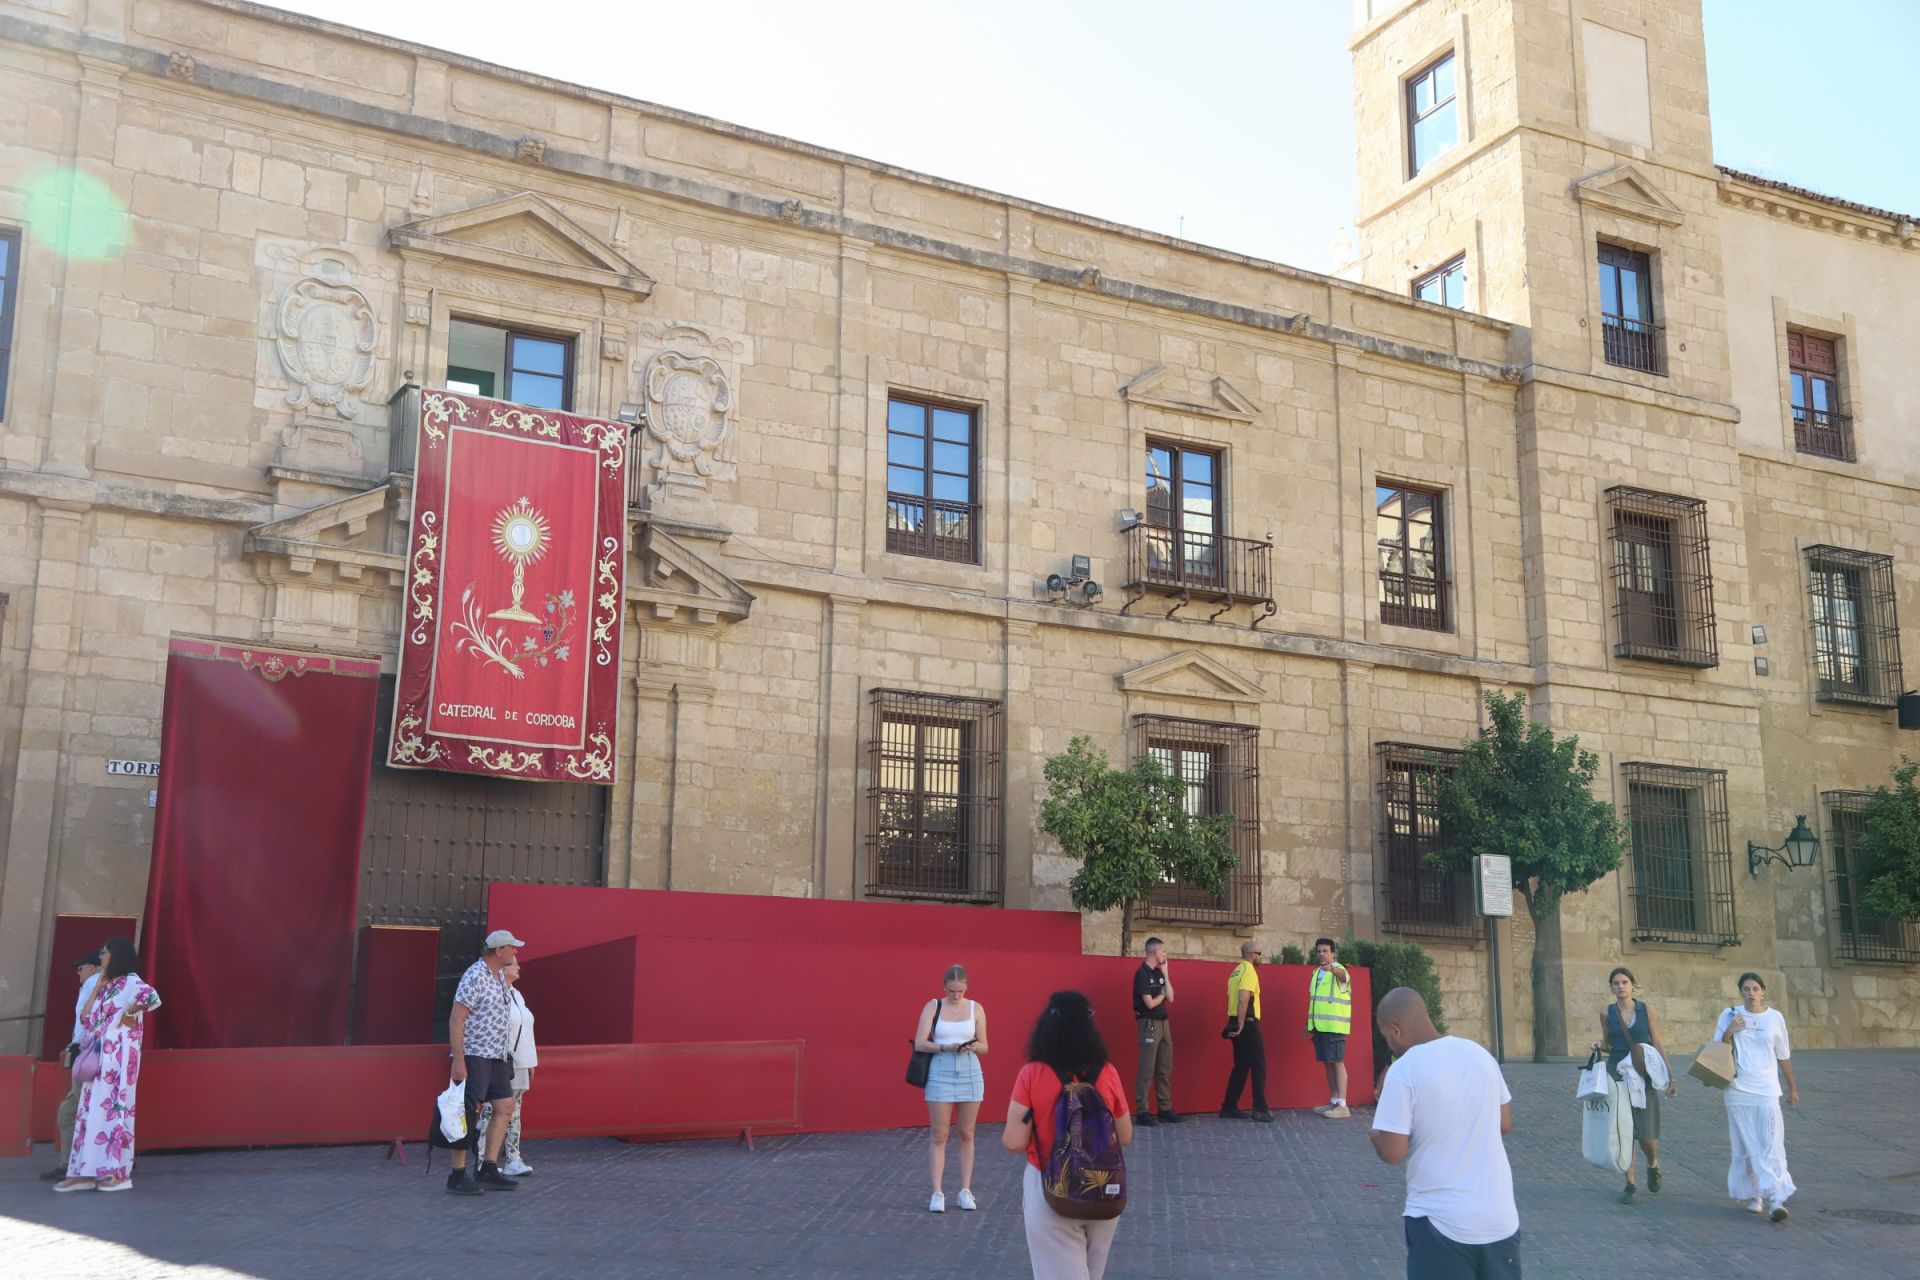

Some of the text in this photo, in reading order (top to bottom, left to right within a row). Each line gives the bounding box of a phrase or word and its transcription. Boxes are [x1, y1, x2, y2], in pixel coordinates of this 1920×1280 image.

[438, 703, 576, 729] CATEDRAL DE CORDOBA
